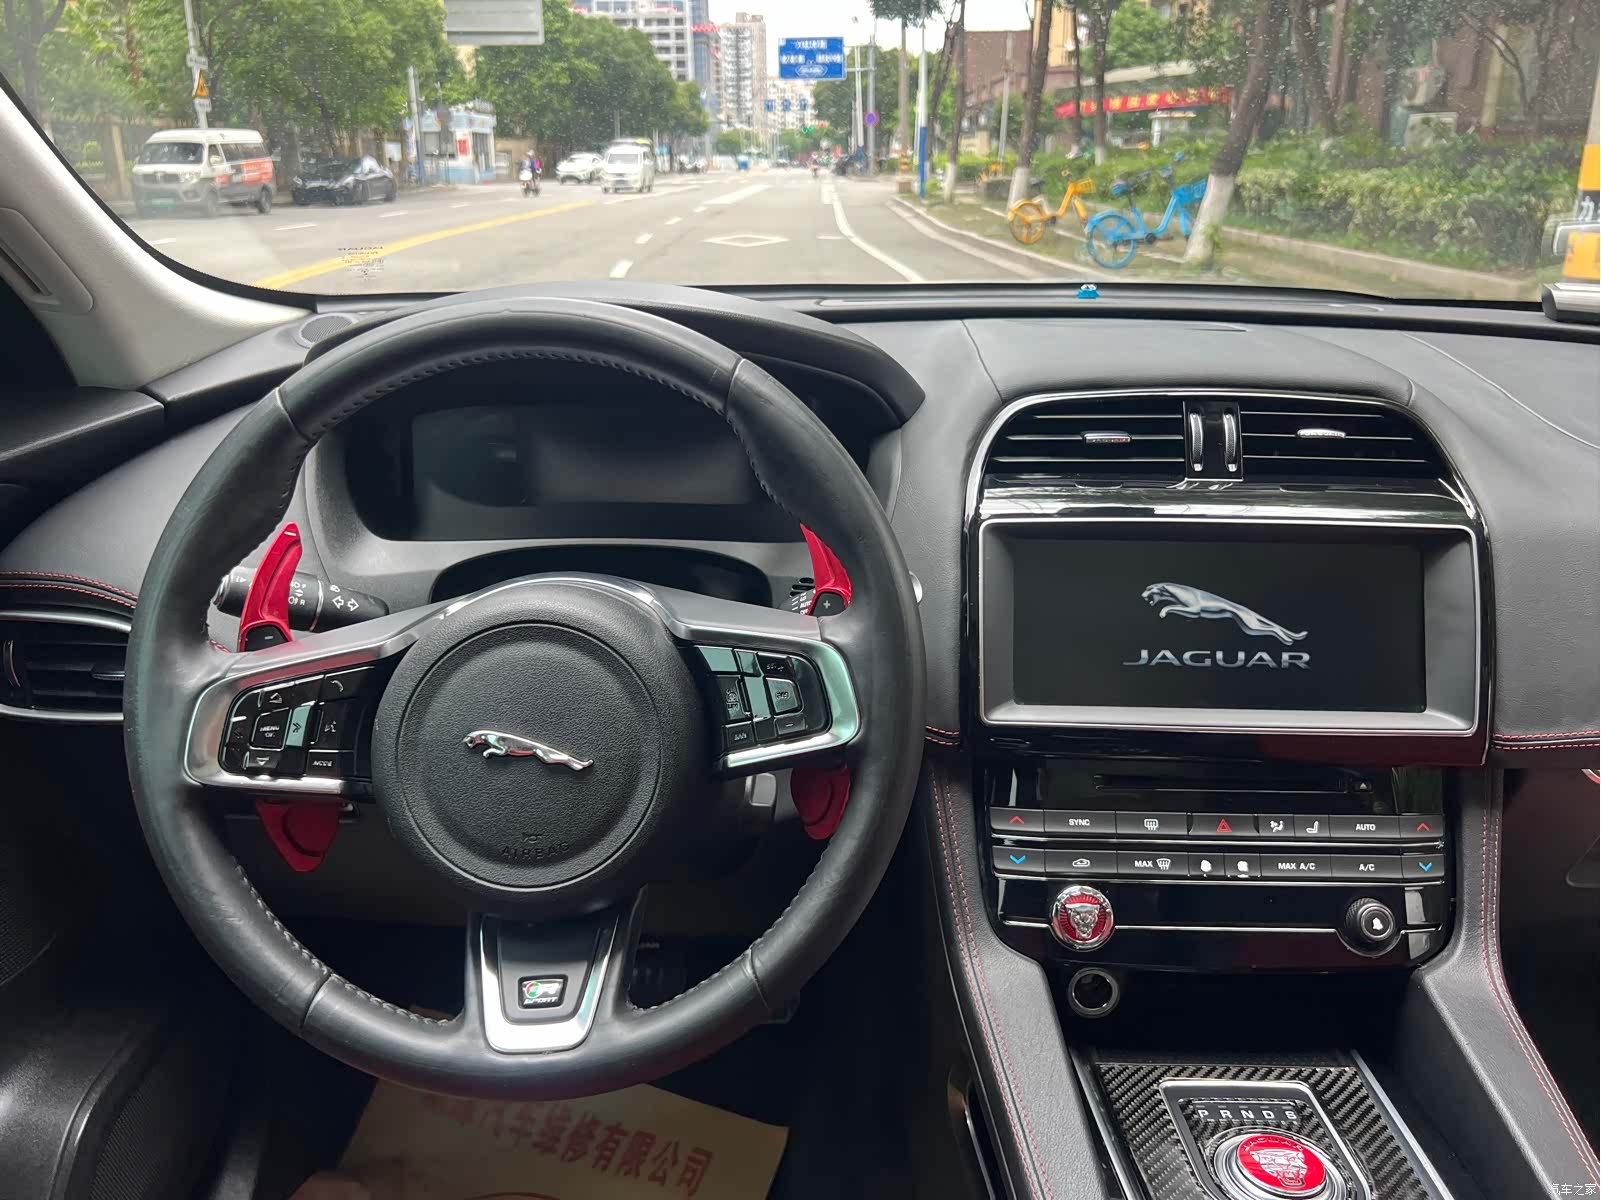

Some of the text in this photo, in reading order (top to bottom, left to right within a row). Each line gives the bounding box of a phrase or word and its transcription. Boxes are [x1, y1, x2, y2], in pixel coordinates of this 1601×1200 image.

[1123, 649, 1311, 669] JAGUAR
[1068, 818, 1091, 827] SYNC
[1355, 823, 1376, 831] AUTO
[501, 841, 570, 860] AIRBAG
[1134, 860, 1153, 868] MAX
[1278, 862, 1316, 871] MAX A/C
[1358, 863, 1375, 872] A/C
[523, 996, 558, 1005] SPORT
[1197, 1109, 1298, 1120] P R N D S
